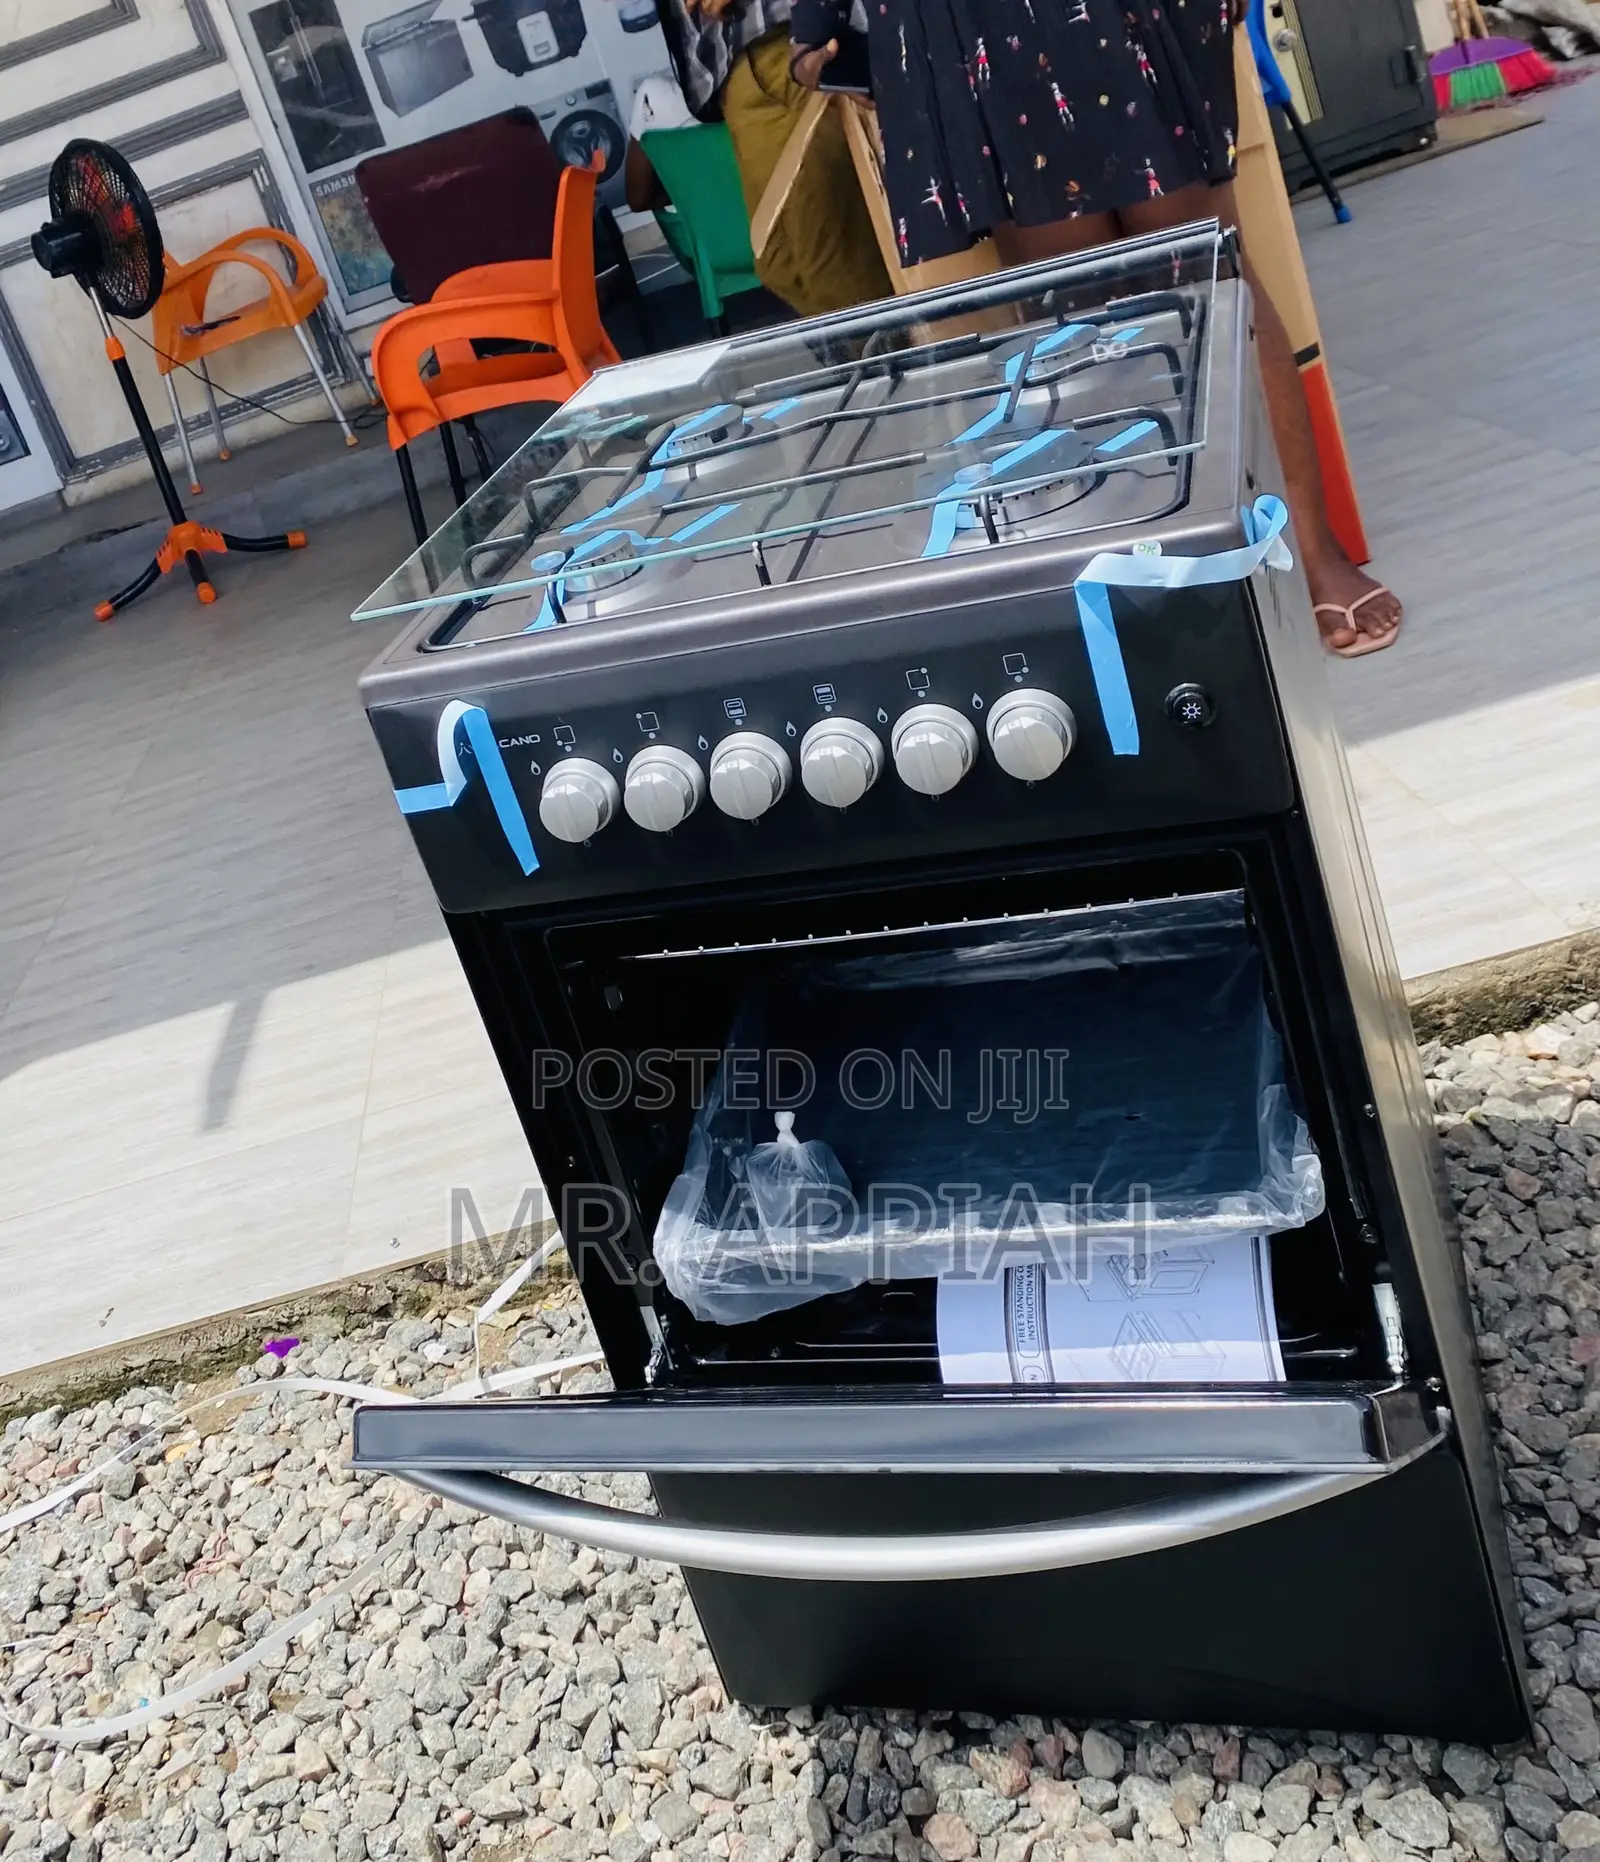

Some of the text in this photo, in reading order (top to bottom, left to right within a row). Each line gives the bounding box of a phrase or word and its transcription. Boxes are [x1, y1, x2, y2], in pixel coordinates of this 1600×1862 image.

[315, 174, 356, 197] SAMSU
[1017, 1275, 1025, 1318] STANDING
[1026, 1280, 1036, 1340] INSTRUCTION
[1018, 1321, 1026, 1343] FREE
